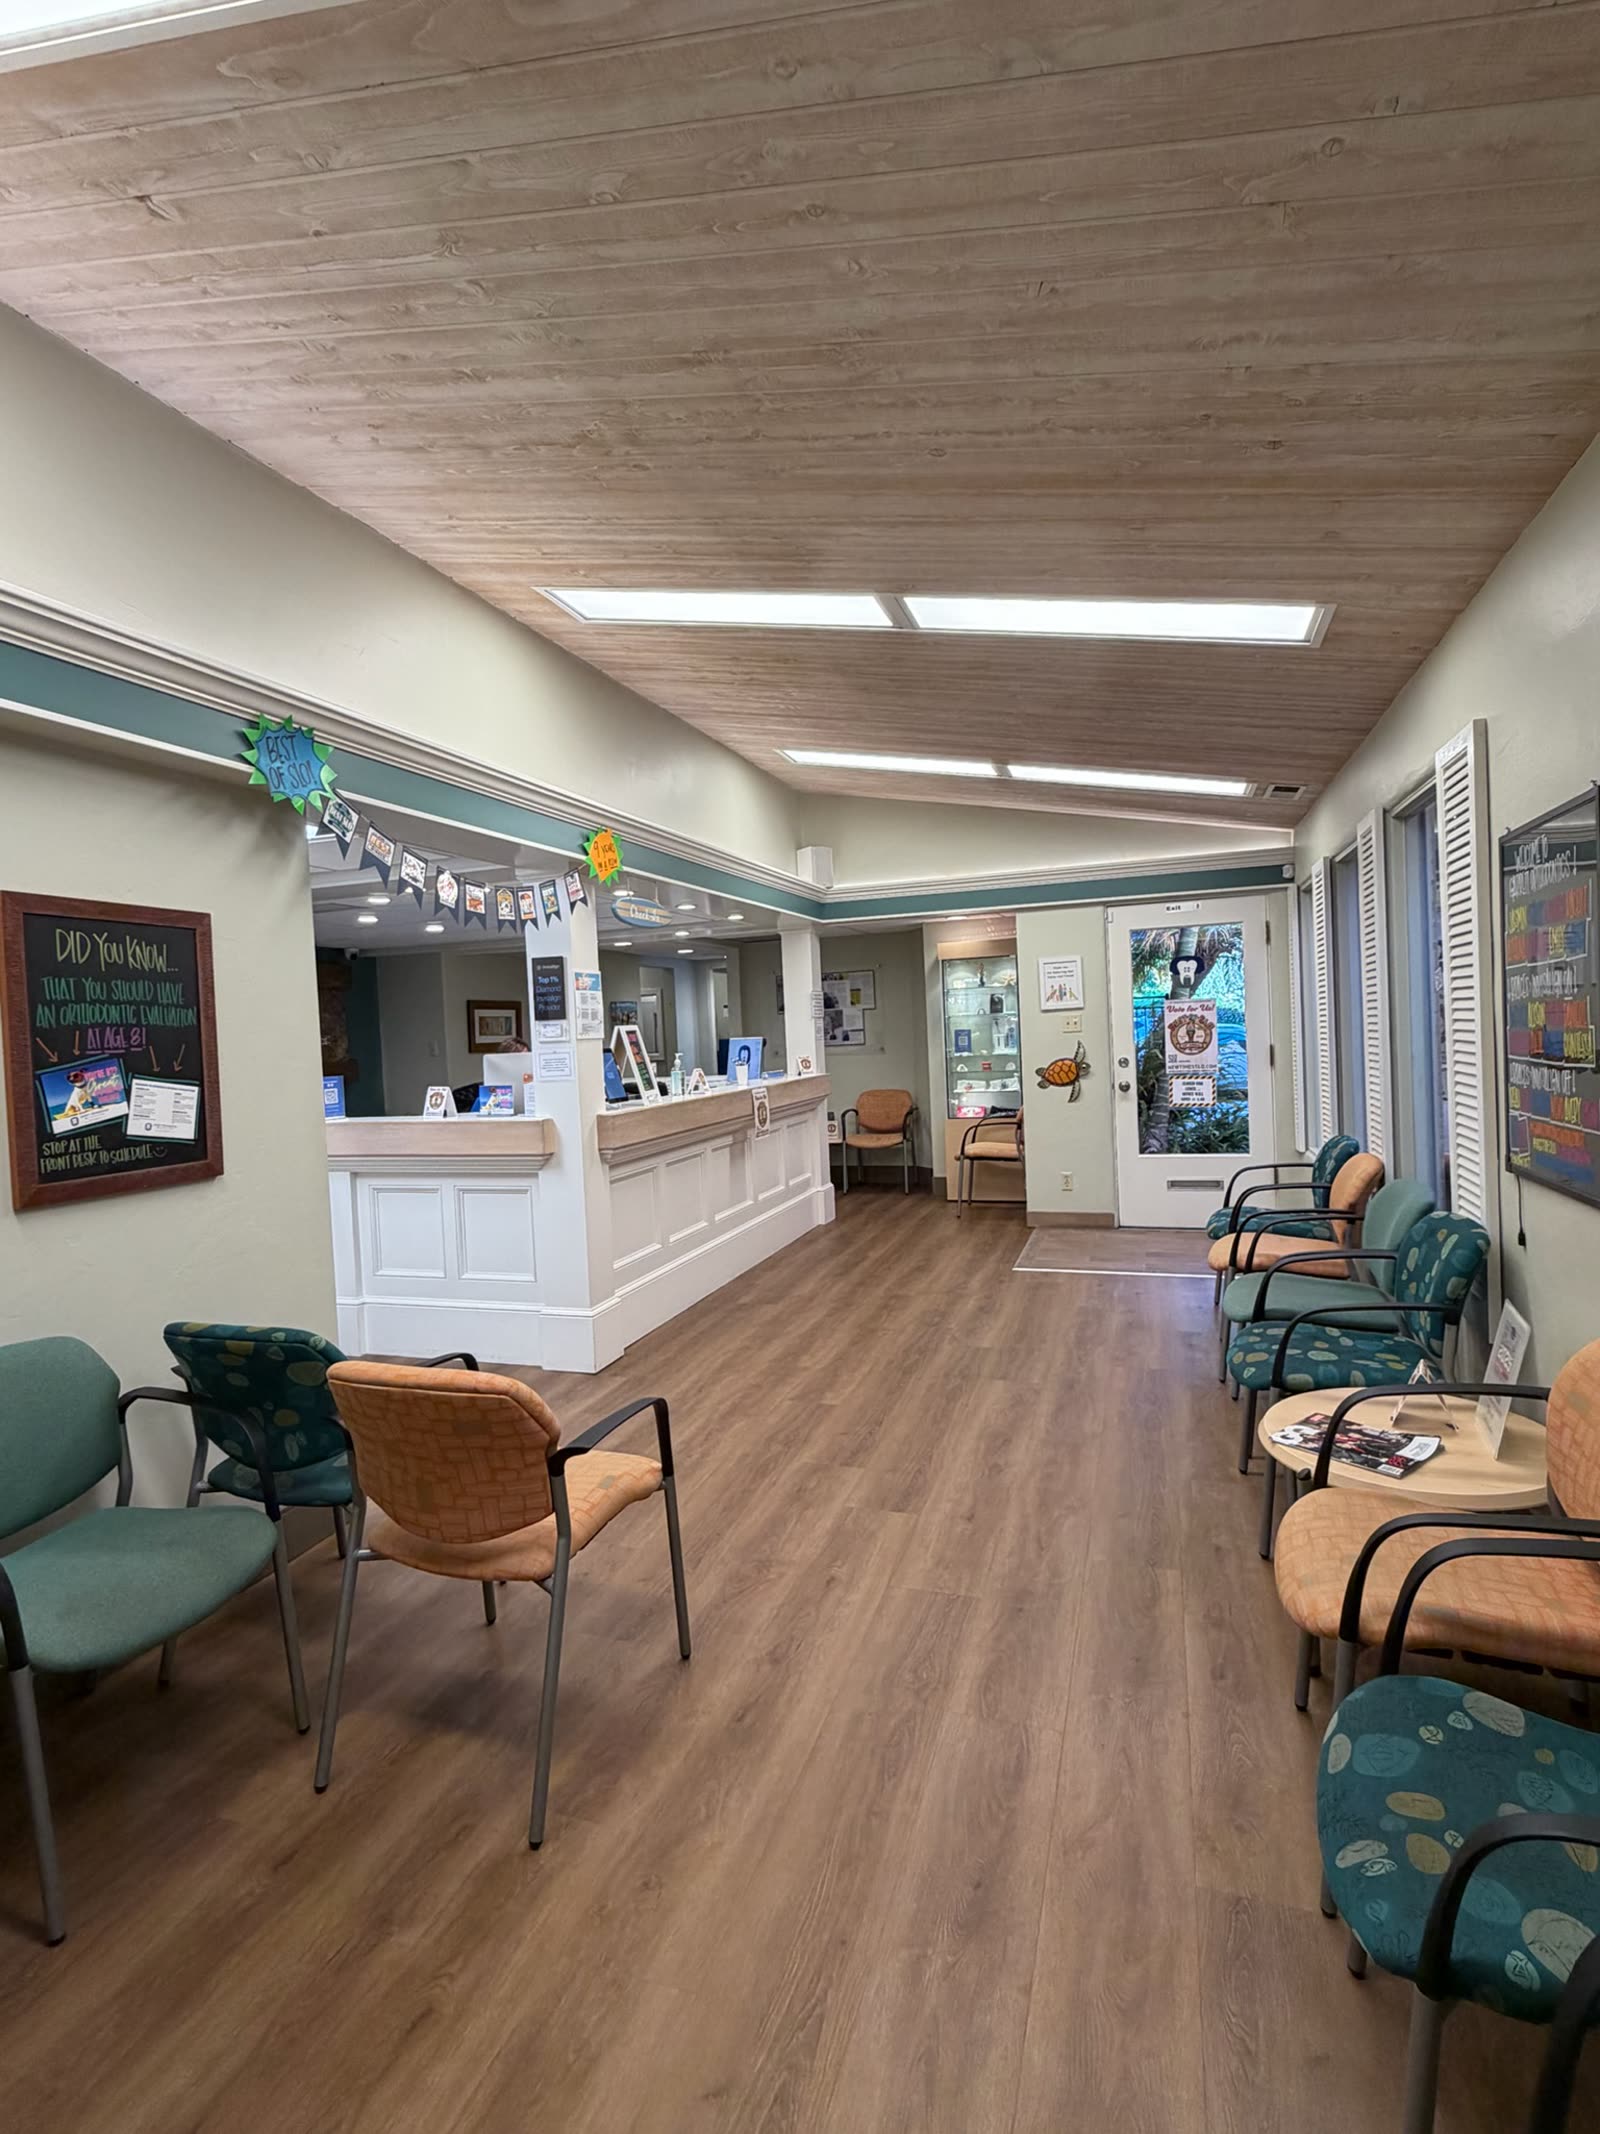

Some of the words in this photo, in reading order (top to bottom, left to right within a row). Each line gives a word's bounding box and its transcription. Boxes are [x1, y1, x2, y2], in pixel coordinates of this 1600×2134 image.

[266, 735, 299, 763] BEST
[269, 765, 286, 790] OF
[287, 760, 317, 789] SLO!
[56, 928, 91, 964] DID
[127, 935, 179, 973] KNOW...
[40, 976, 78, 1000] THAT
[82, 977, 106, 1001] YOU
[111, 978, 153, 1001] SHOULD
[157, 982, 184, 1005] HAVE
[538, 976, 549, 984] Top
[36, 1004, 56, 1028] AN
[60, 1003, 137, 1026] ORTHODONTIC
[140, 1005, 197, 1028] EVALUATION
[1187, 1004, 1198, 1012] for
[1200, 1004, 1215, 1012] Us!
[88, 1027, 102, 1050] AT
[104, 1027, 129, 1050] AGE
[43, 1140, 69, 1156] STOP
[70, 1138, 81, 1153] AT
[84, 1135, 102, 1150] THE
[40, 1155, 71, 1174] FRONT
[72, 1152, 97, 1169] DESK
[99, 1151, 109, 1163] TO
[111, 1144, 154, 1164] SCHEDULE
